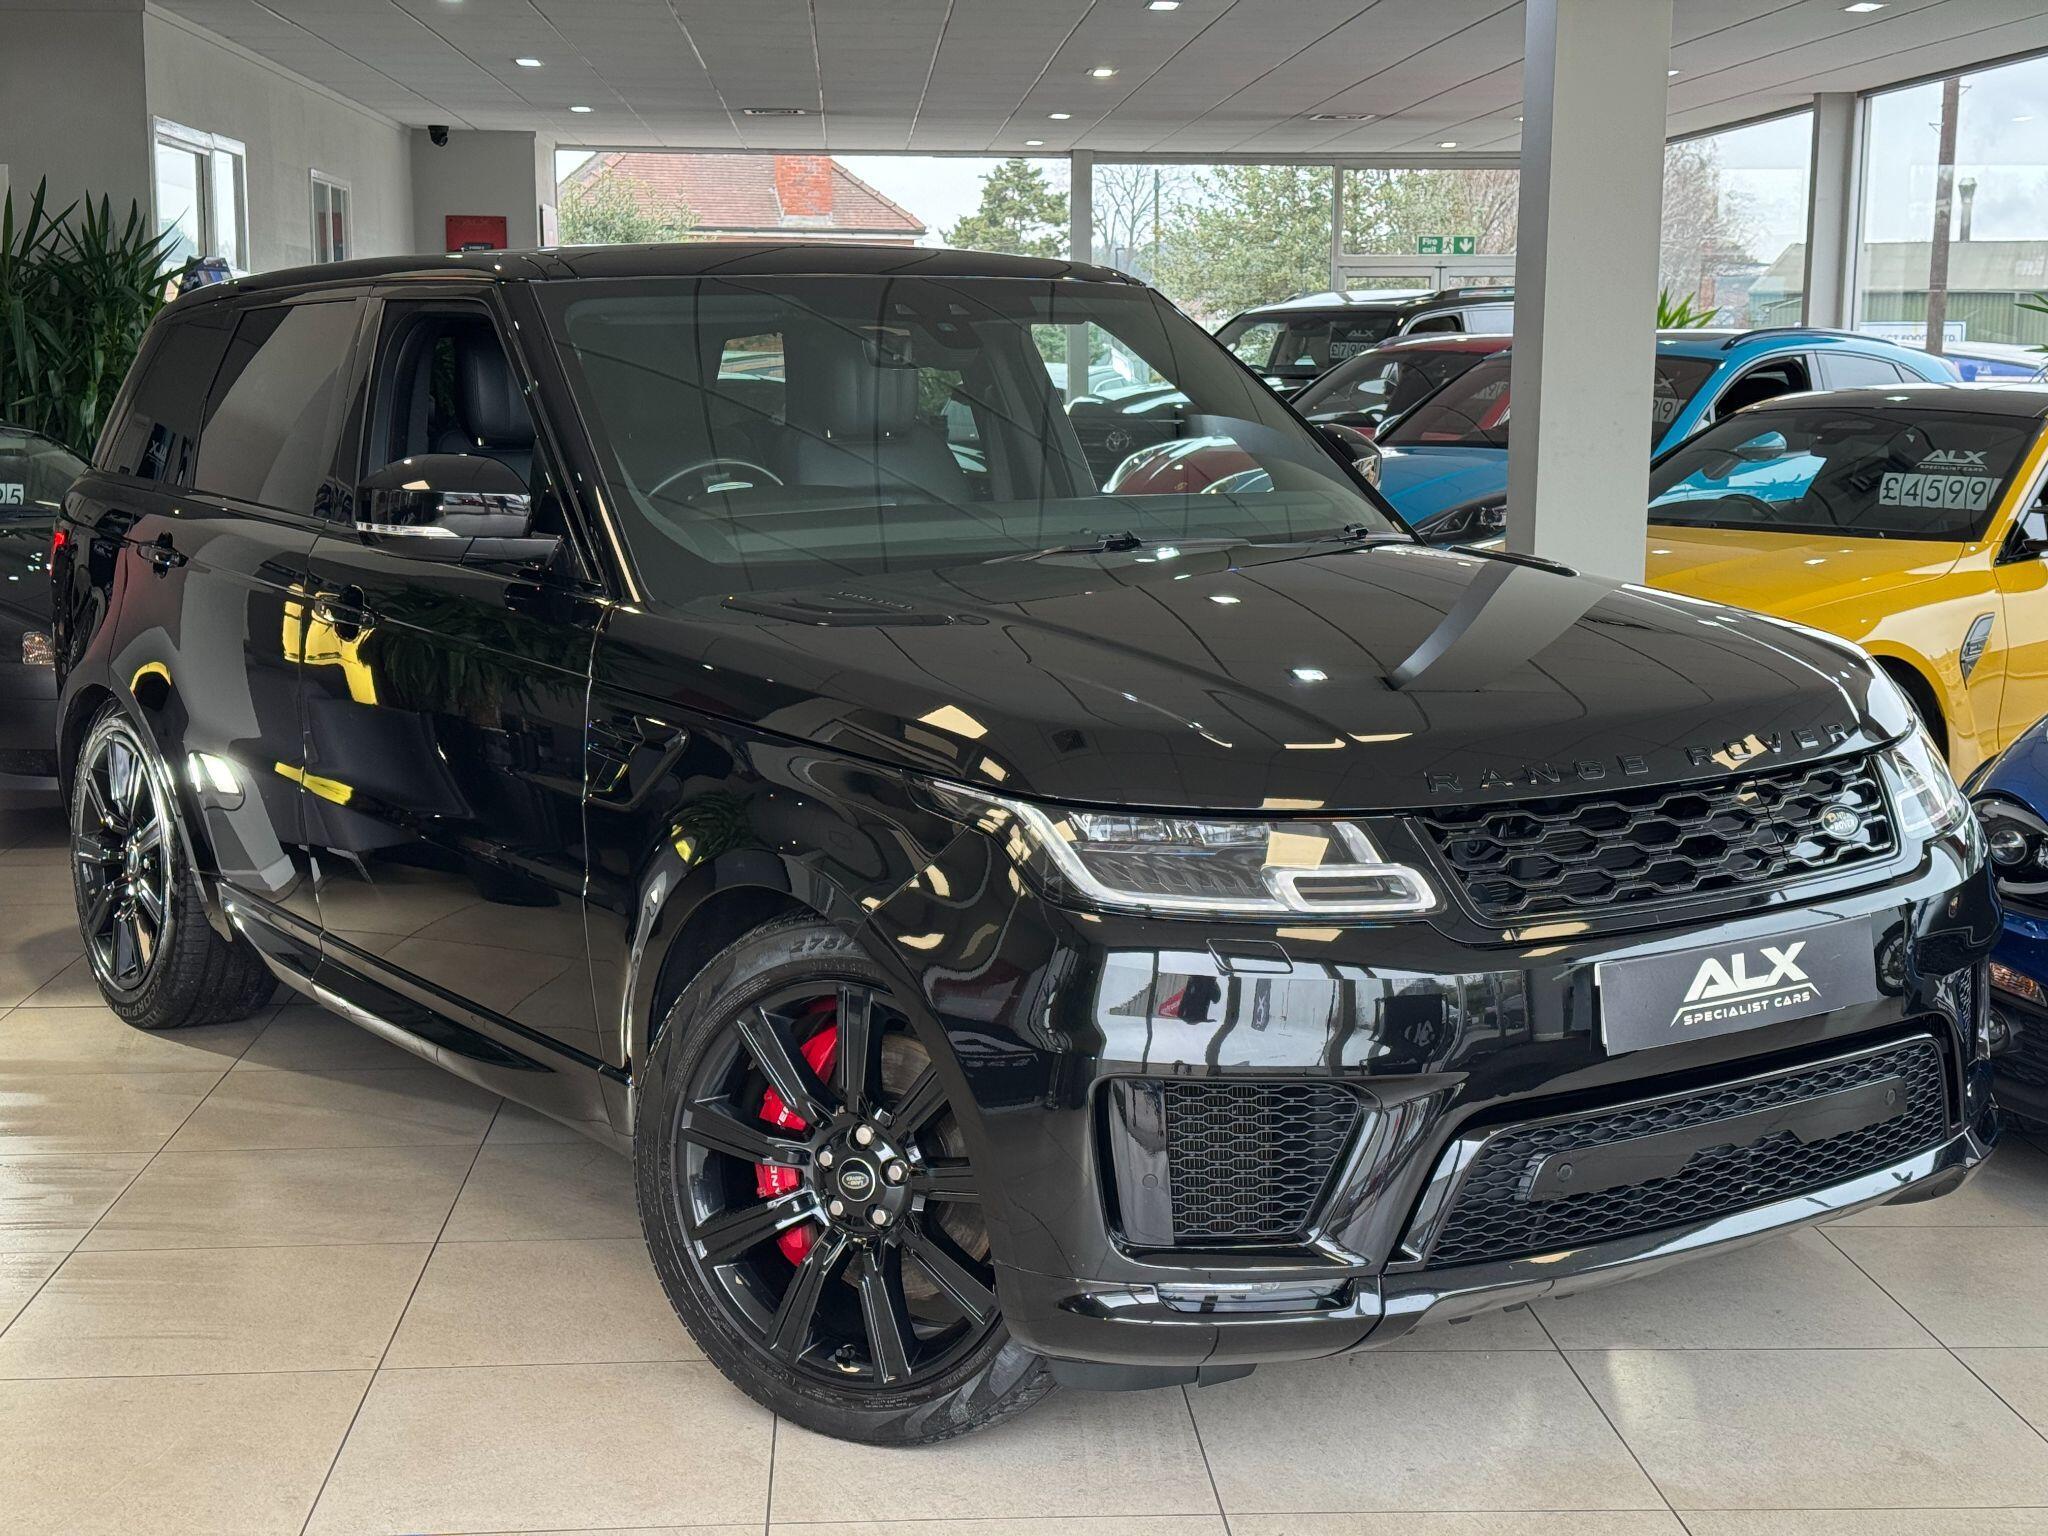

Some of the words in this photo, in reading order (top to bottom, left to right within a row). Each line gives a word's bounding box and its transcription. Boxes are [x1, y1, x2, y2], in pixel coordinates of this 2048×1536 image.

[1422, 237, 1438, 245] Fire
[1347, 329, 1374, 337] ALX
[1921, 449, 1987, 465] ALX
[1882, 477, 1987, 505] £4599
[1423, 753, 1649, 793] RANGE
[1684, 722, 1850, 766] ROVER
[1683, 941, 1809, 1003] ALX
[1683, 1000, 1770, 1026] SPECIALIST
[1774, 991, 1811, 1008] CARS
